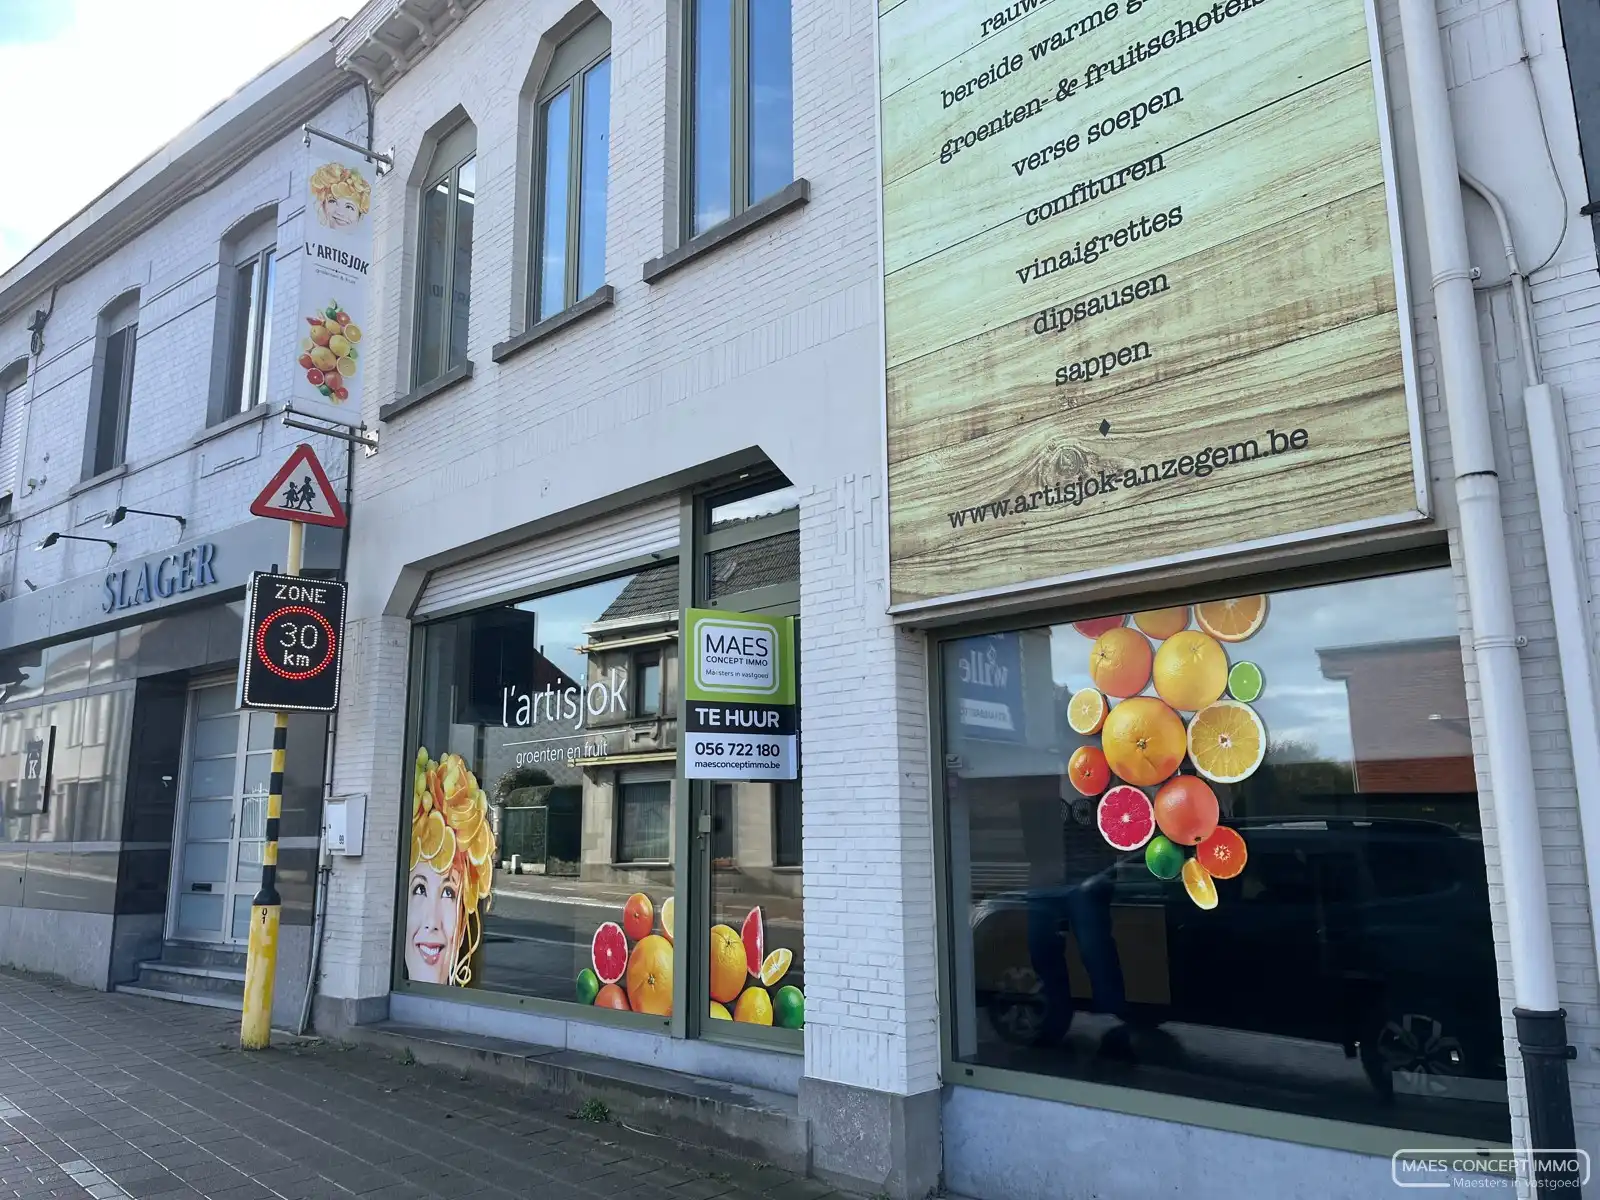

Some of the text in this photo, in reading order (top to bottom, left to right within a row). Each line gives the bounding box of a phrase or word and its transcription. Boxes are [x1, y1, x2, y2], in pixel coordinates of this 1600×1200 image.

[980, 0, 1047, 38] rauw
[940, 53, 1023, 110] bereide
[1028, 2, 1119, 61] warme
[939, 95, 1050, 165] groenten-
[1055, 78, 1078, 102] &
[1011, 85, 1184, 178] verse soepen
[1025, 152, 1167, 226] confituren
[305, 241, 370, 275] L'ARTISJOK
[1015, 205, 1184, 284] vinaigrettes
[1033, 272, 1171, 335] dipsausen
[1055, 340, 1153, 387] sappen
[947, 427, 1309, 529] www.artisjok-anzegem.be
[101, 542, 216, 614] SLAGER
[274, 583, 328, 605] ZONE
[279, 621, 319, 650] 30
[705, 633, 769, 657] MAES
[283, 649, 311, 667] km
[705, 655, 768, 667] CONCEPT IMMO
[741, 672, 769, 680] vastgoed
[502, 667, 628, 731] l'artisjok
[694, 707, 780, 728] TE HUUR
[516, 740, 608, 769] groenten en fruit
[694, 760, 781, 771] maesconceptimmo.be
[695, 741, 780, 757] 056 722 180
[27, 759, 39, 779] K
